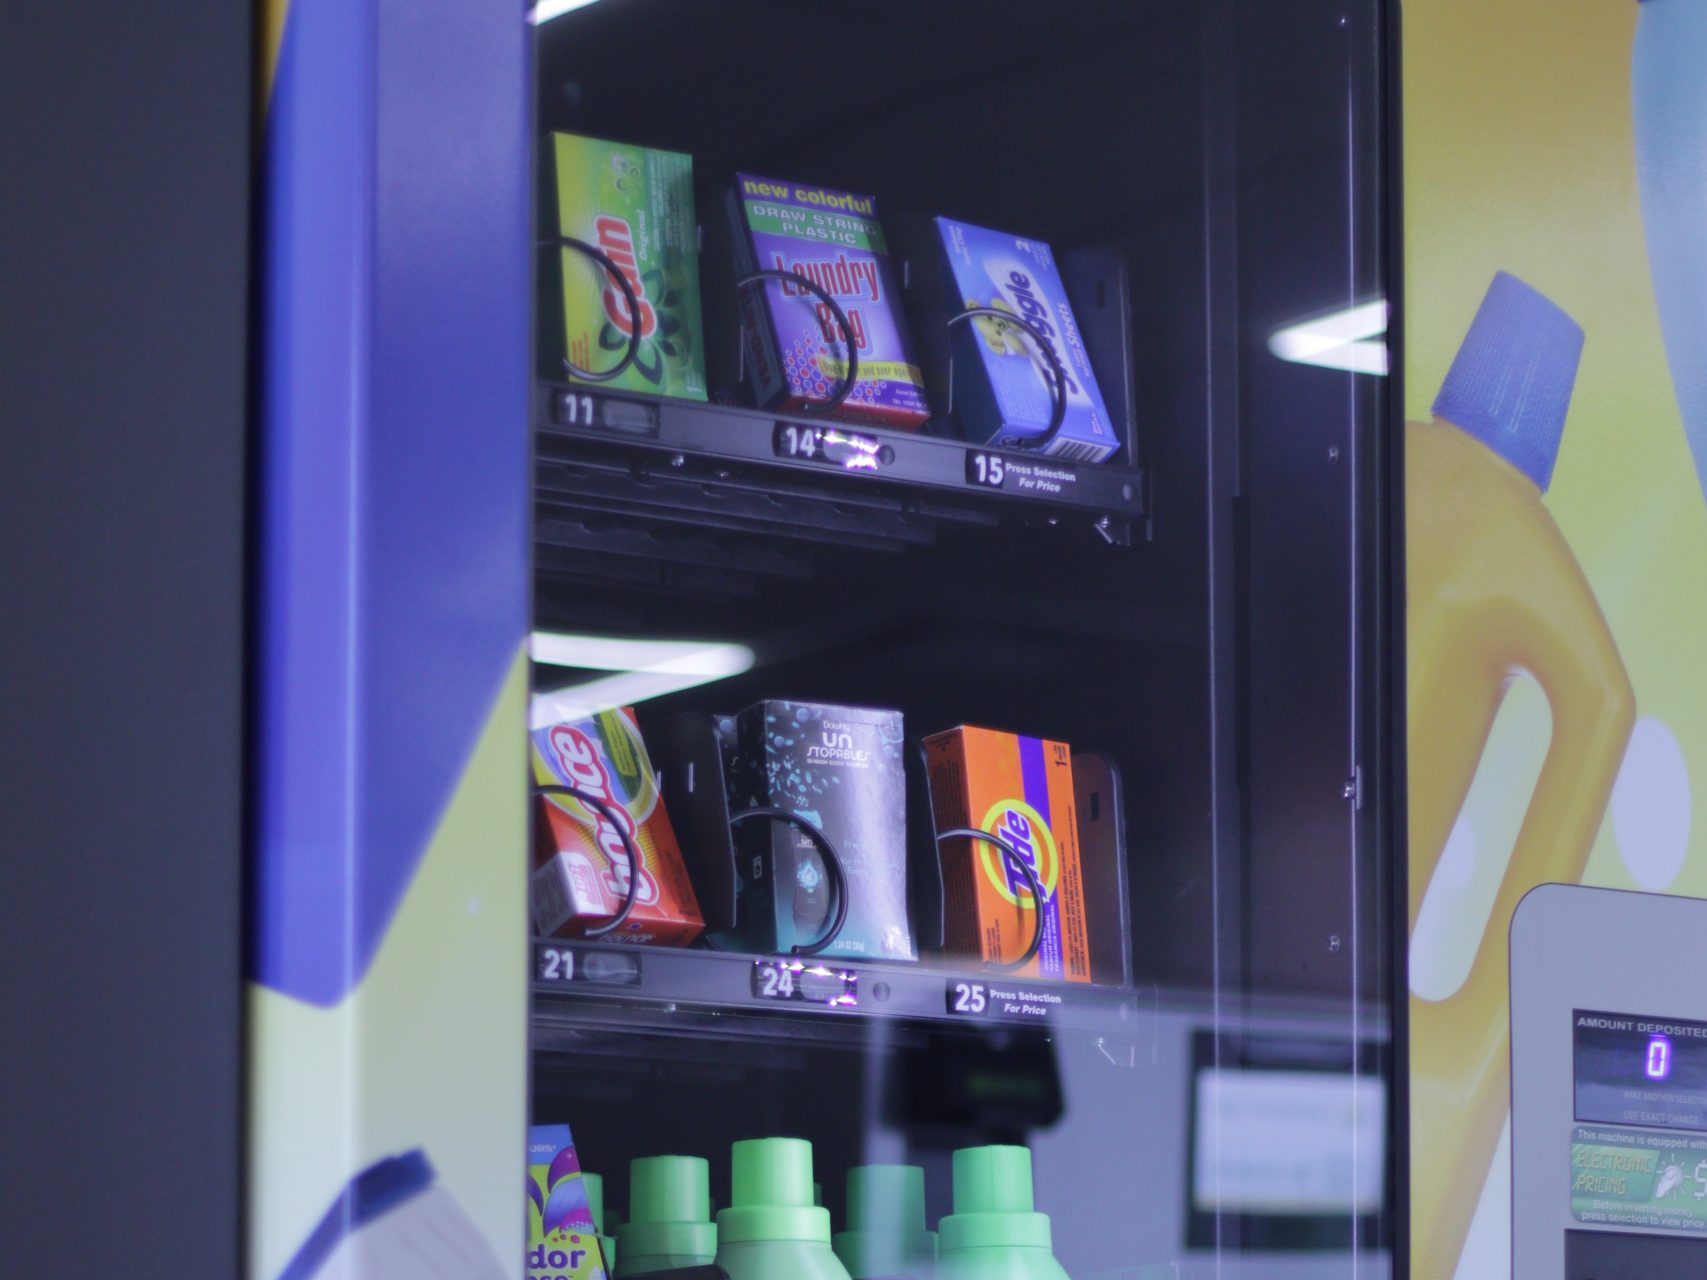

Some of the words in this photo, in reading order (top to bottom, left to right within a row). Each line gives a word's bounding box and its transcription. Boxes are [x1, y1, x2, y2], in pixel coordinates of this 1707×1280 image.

[744, 181, 788, 199] new
[795, 189, 873, 215] colorful
[753, 205, 806, 222] DRAW
[813, 215, 877, 235] STRING
[782, 222, 857, 244] PLASTIC
[775, 254, 880, 302] Laundry
[815, 302, 867, 350] Bag
[565, 394, 594, 426] 11
[785, 427, 816, 457] 14
[975, 455, 1004, 484] 15
[1005, 463, 1032, 478] Press
[1033, 466, 1076, 483] Selection
[1019, 478, 1035, 489] For
[1036, 480, 1061, 493] Price
[544, 950, 574, 980] 21
[763, 967, 794, 997] 24
[955, 984, 985, 1013] 25
[990, 990, 1016, 1002] Press
[1018, 991, 1062, 1004] Selection
[1004, 1003, 1019, 1014] For
[1020, 1004, 1047, 1016] Price
[1577, 1017, 1634, 1031] AMOUNT
[1648, 1041, 1667, 1077] 0
[1578, 1129, 1596, 1140] This
[1598, 1132, 1635, 1144] machine
[1637, 1135, 1645, 1144] is
[1647, 1137, 1688, 1149] equipped
[1577, 1150, 1652, 1174] ELECTRONIC
[1574, 1174, 1627, 1195] PRICING
[1582, 1212, 1607, 1222] press
[1609, 1213, 1648, 1224] selection
[1662, 1217, 1680, 1227] view
[1683, 1218, 1705, 1229] price
[1594, 1200, 1626, 1210] Before
[1627, 1202, 1663, 1215] inserting
